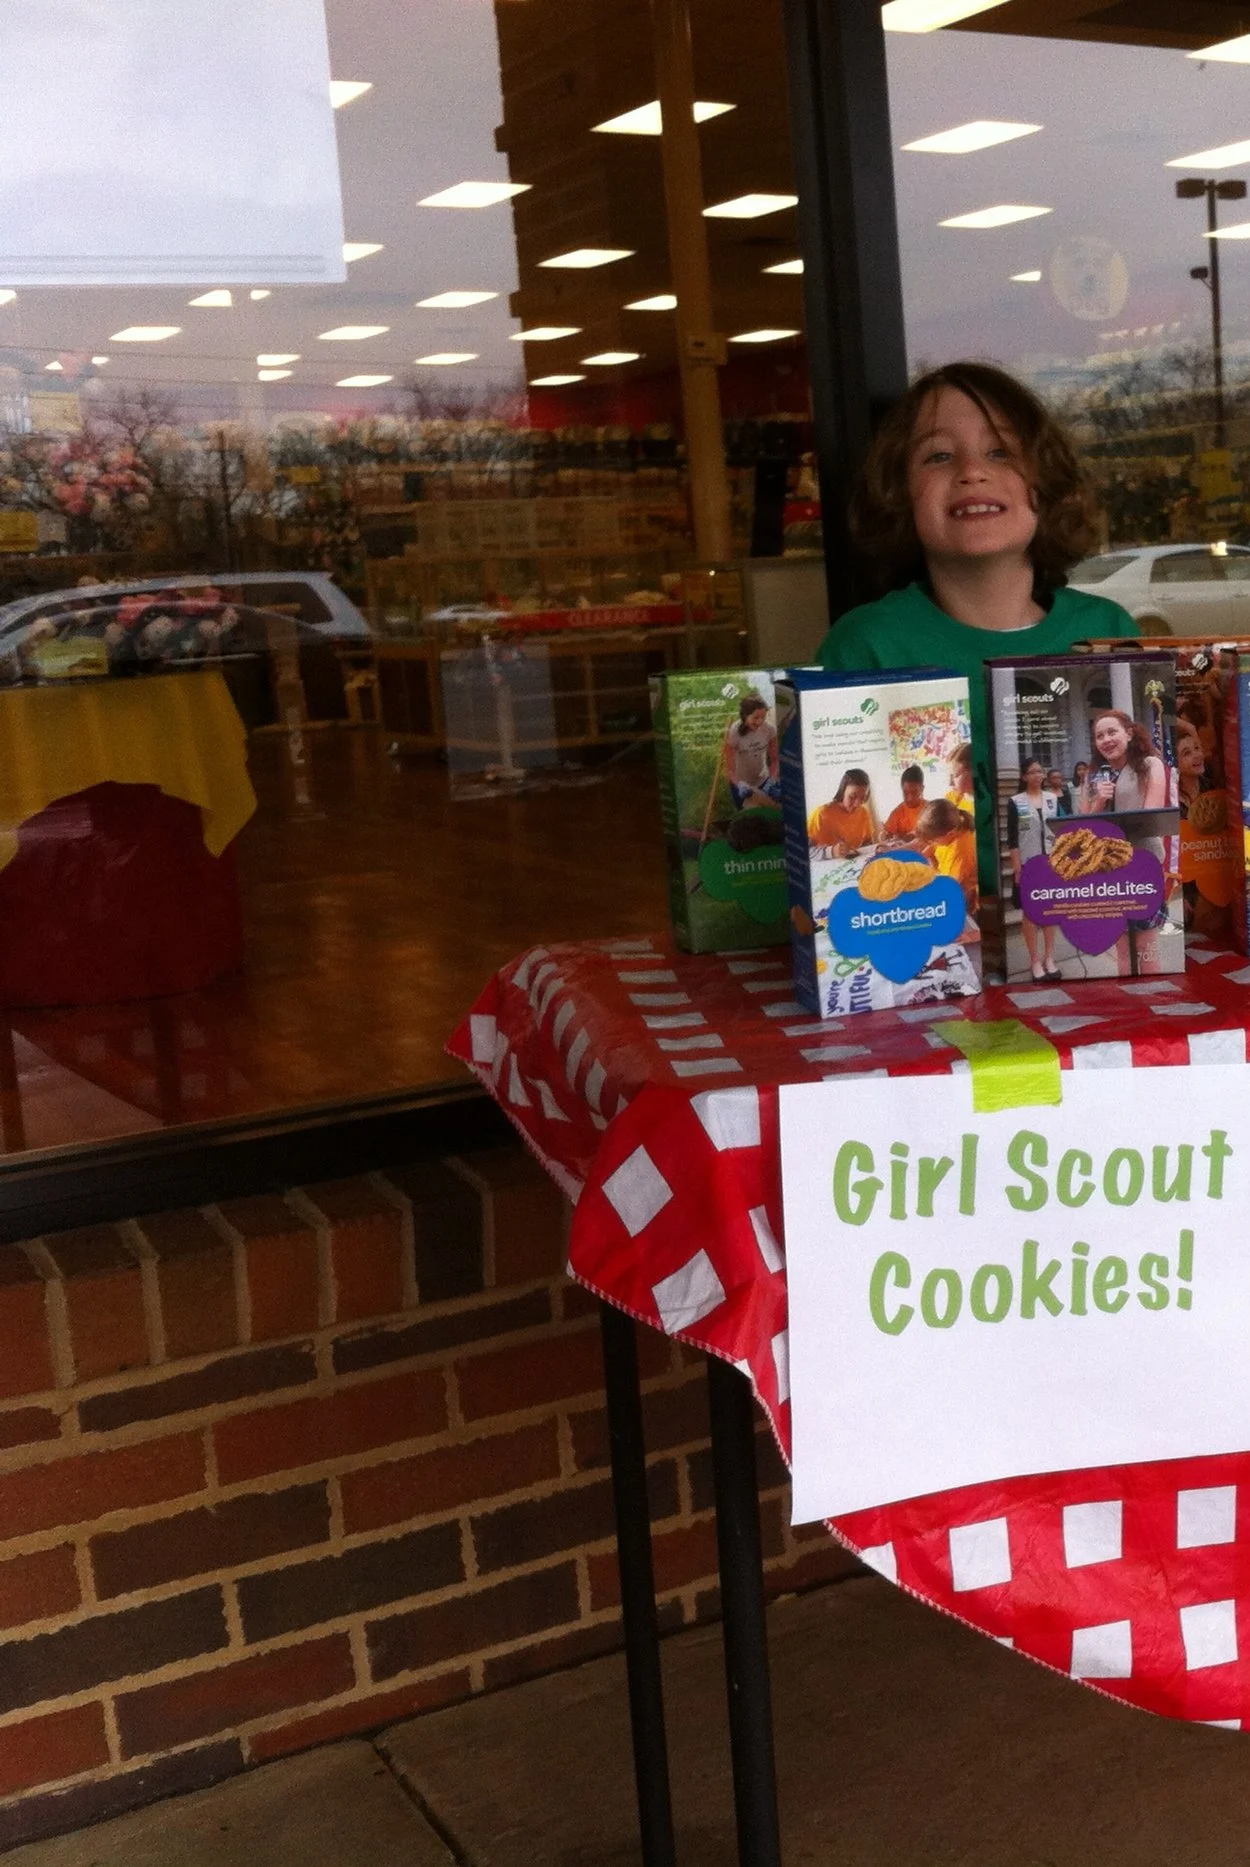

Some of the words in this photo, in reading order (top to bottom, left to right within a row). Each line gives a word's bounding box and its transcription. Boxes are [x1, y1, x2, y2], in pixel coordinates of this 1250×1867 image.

[1003, 693, 1020, 706] girl
[1022, 693, 1055, 703] scouts
[812, 716, 830, 731] girl
[831, 715, 864, 726] scouts
[723, 860, 756, 876] thin
[757, 856, 787, 872] min
[1030, 883, 1095, 901] caramel
[850, 901, 948, 929] shortbread
[832, 1139, 980, 1226] Girl
[1004, 1129, 1234, 1212] Scout
[868, 1228, 1195, 1337] Cookies!
